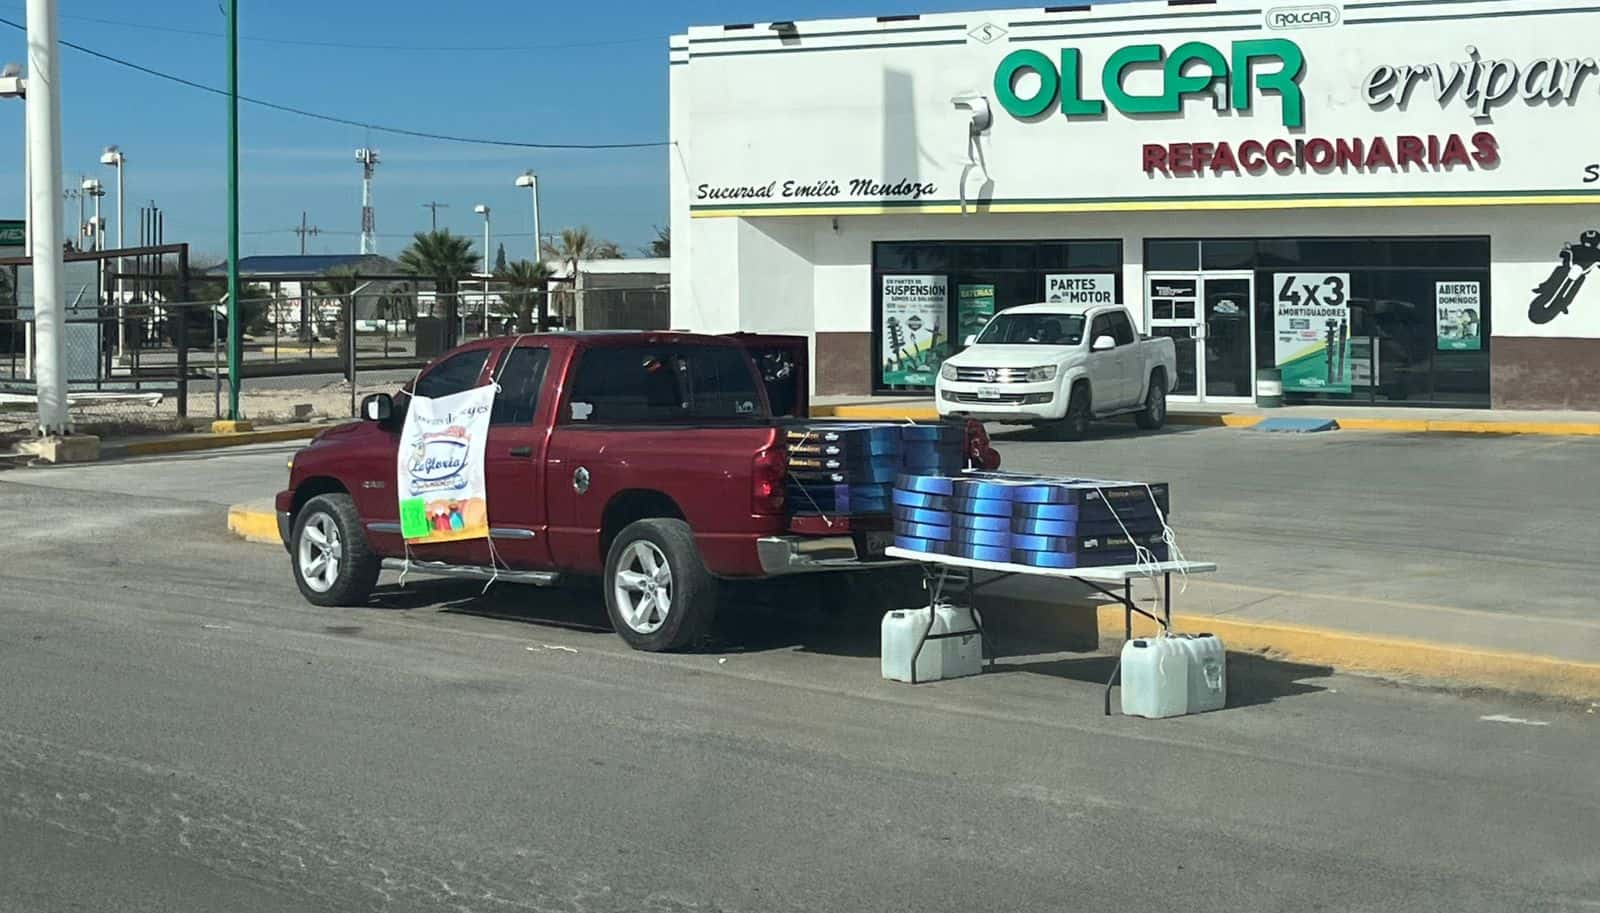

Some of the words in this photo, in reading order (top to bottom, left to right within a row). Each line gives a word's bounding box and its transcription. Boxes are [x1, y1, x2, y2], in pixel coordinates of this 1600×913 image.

[1275, 11, 1331, 27] ROLCAR
[993, 38, 1304, 128] OLCAR
[1142, 131, 1501, 175] REFACCIONARIAS
[697, 181, 777, 199] Sucursal
[782, 180, 841, 198] Emilio
[849, 178, 938, 200] Mendoza
[1050, 279, 1097, 290] PARTES
[1439, 285, 1478, 295] ABIERTO
[884, 285, 946, 296] SUSPENSION
[1070, 291, 1111, 303] MOTOR
[1439, 296, 1478, 305] DOMINGOS
[1279, 308, 1346, 318] AMORTIGUADORES
